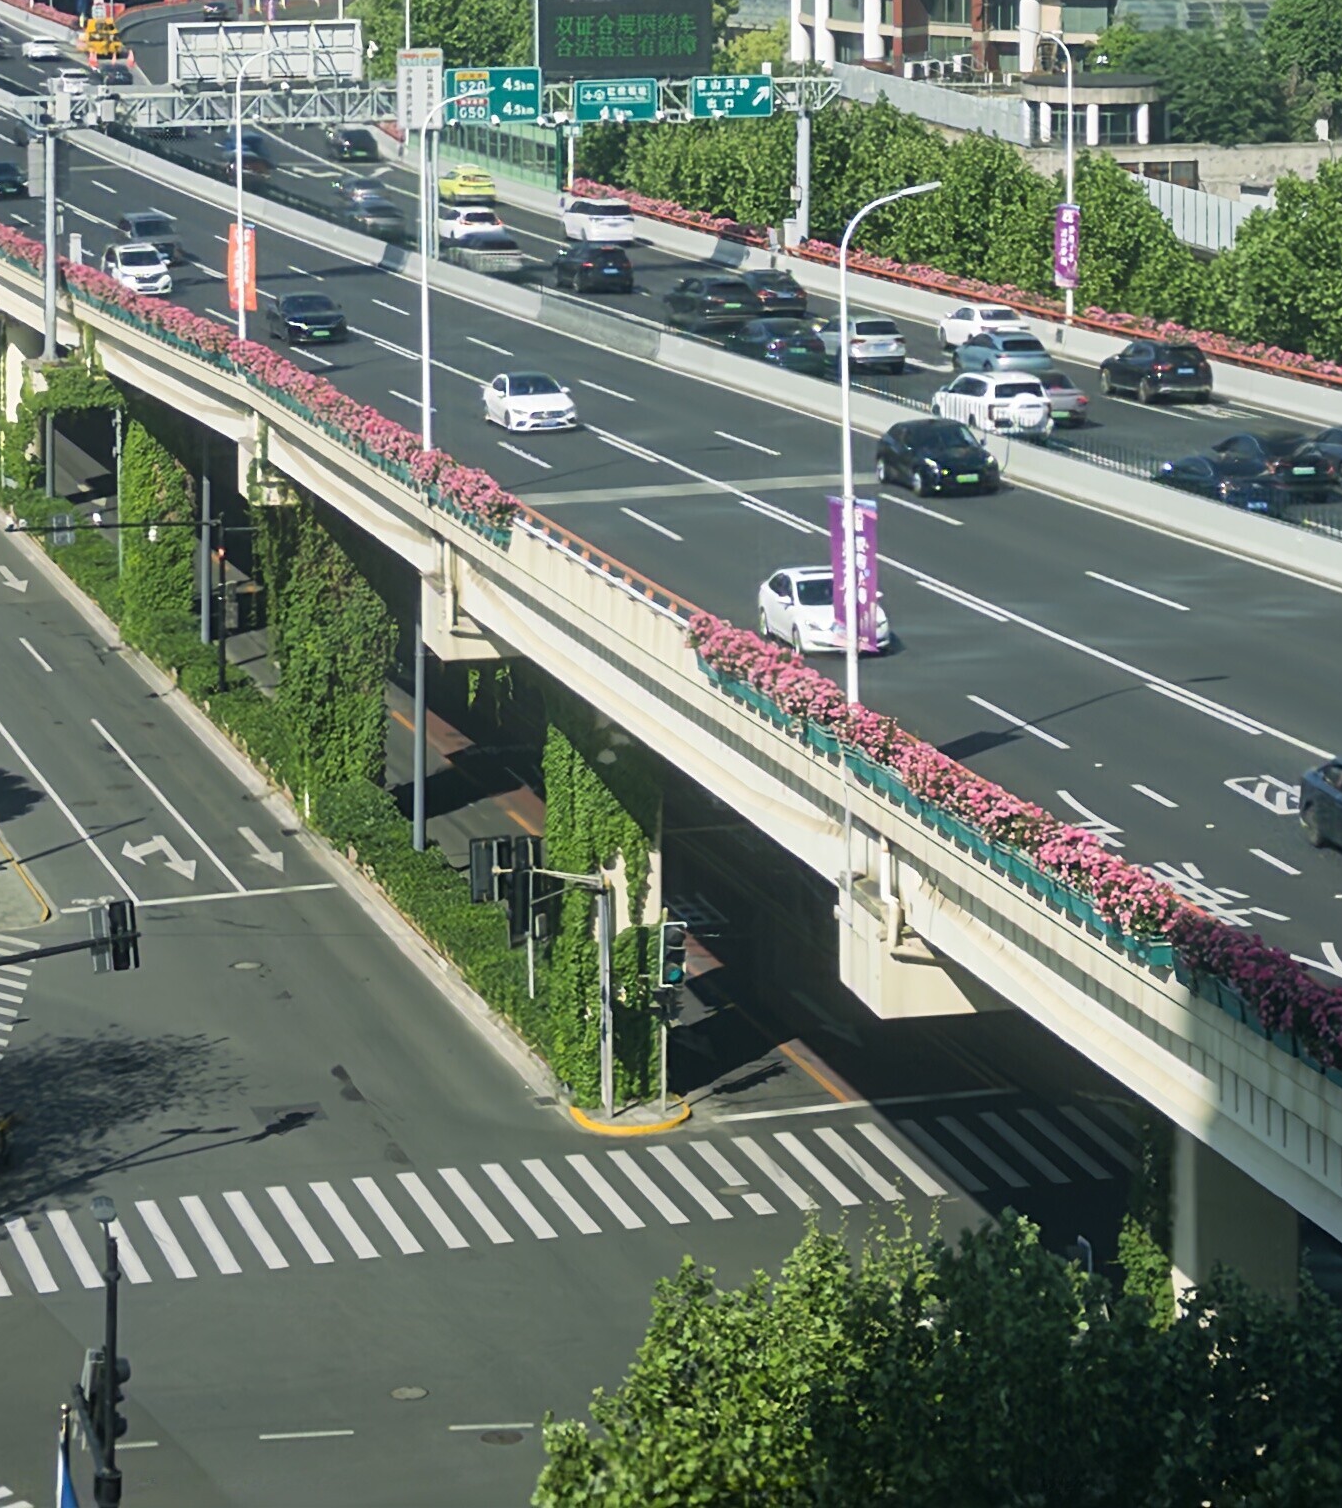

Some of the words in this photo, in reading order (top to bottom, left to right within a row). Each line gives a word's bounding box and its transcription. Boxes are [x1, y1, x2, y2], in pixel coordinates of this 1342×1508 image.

[555, 13, 697, 35] 双证合规网约车
[555, 35, 697, 57] 合法营运有保障
[459, 81, 486, 93] S20
[706, 98, 734, 109] 出口
[459, 106, 486, 119] G50
